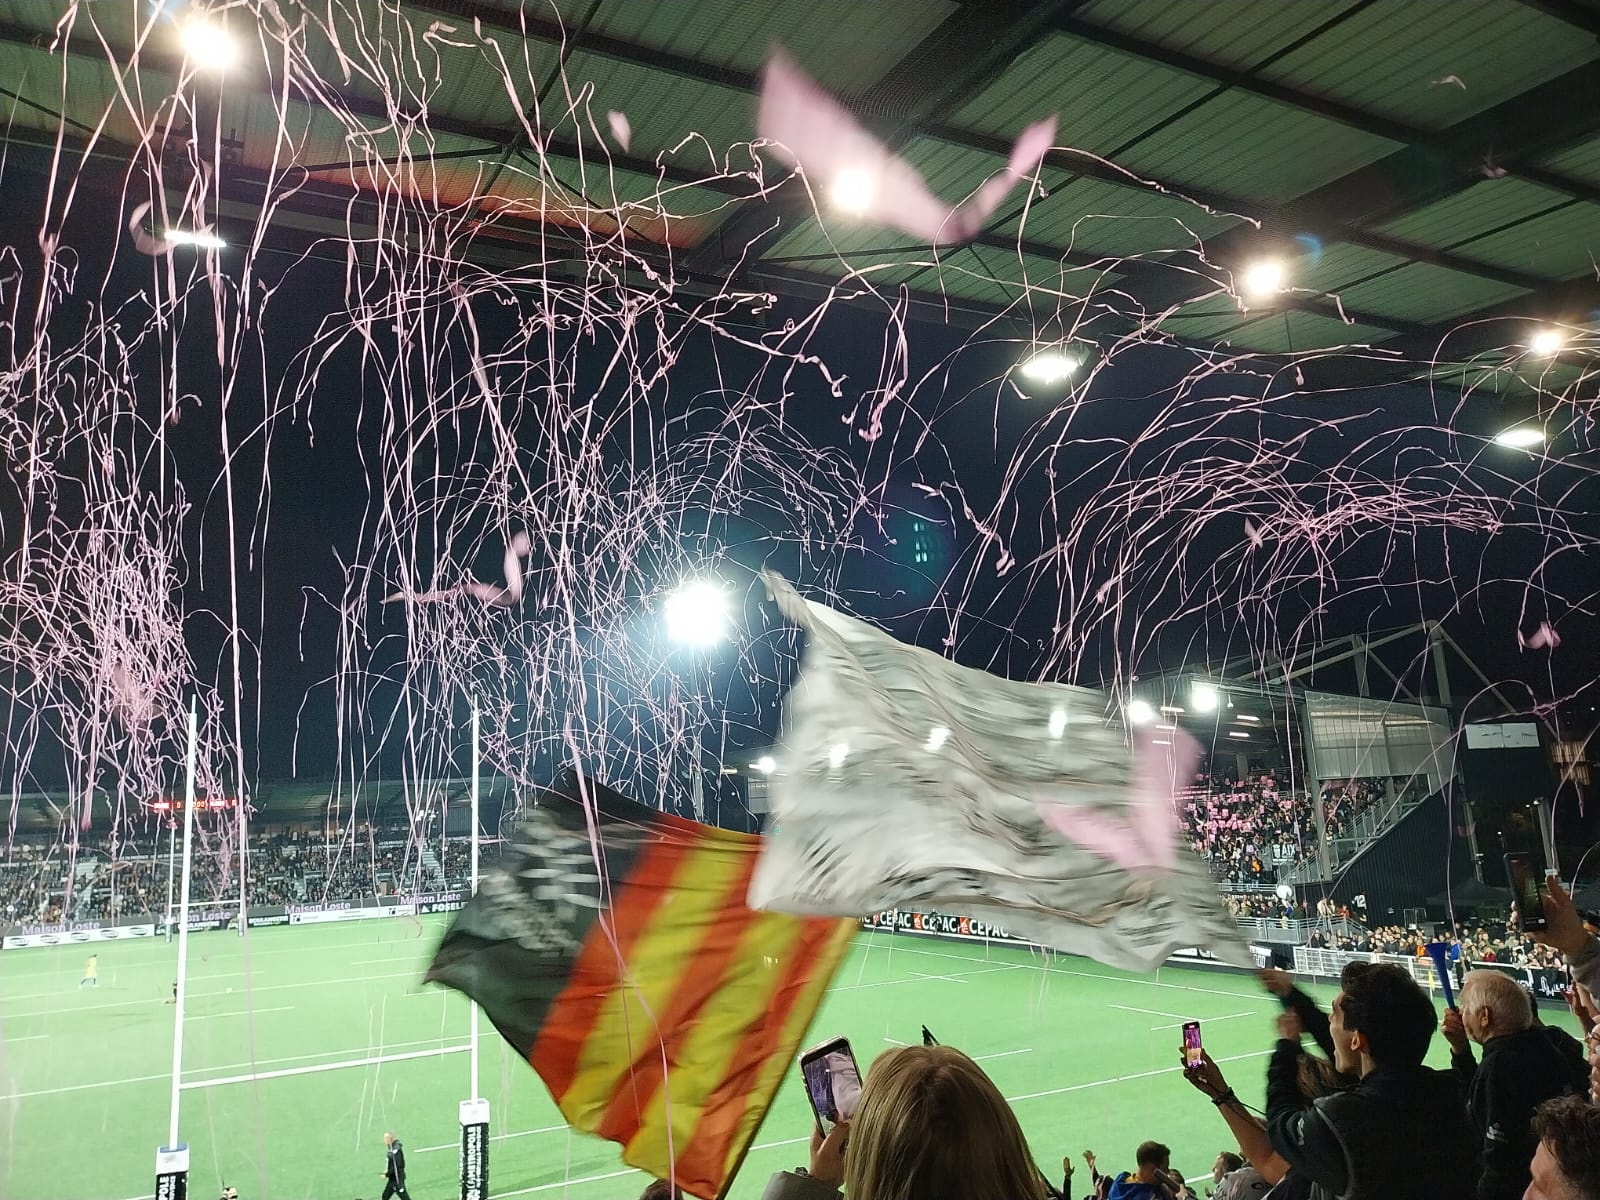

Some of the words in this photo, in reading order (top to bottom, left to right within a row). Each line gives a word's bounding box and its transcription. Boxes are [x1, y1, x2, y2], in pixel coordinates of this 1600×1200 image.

[436, 893, 461, 902] Loste
[284, 905, 322, 915] Maison
[324, 902, 351, 911] Loste
[202, 911, 231, 921] Loste
[22, 925, 66, 935] Maison
[69, 921, 100, 931] Loste
